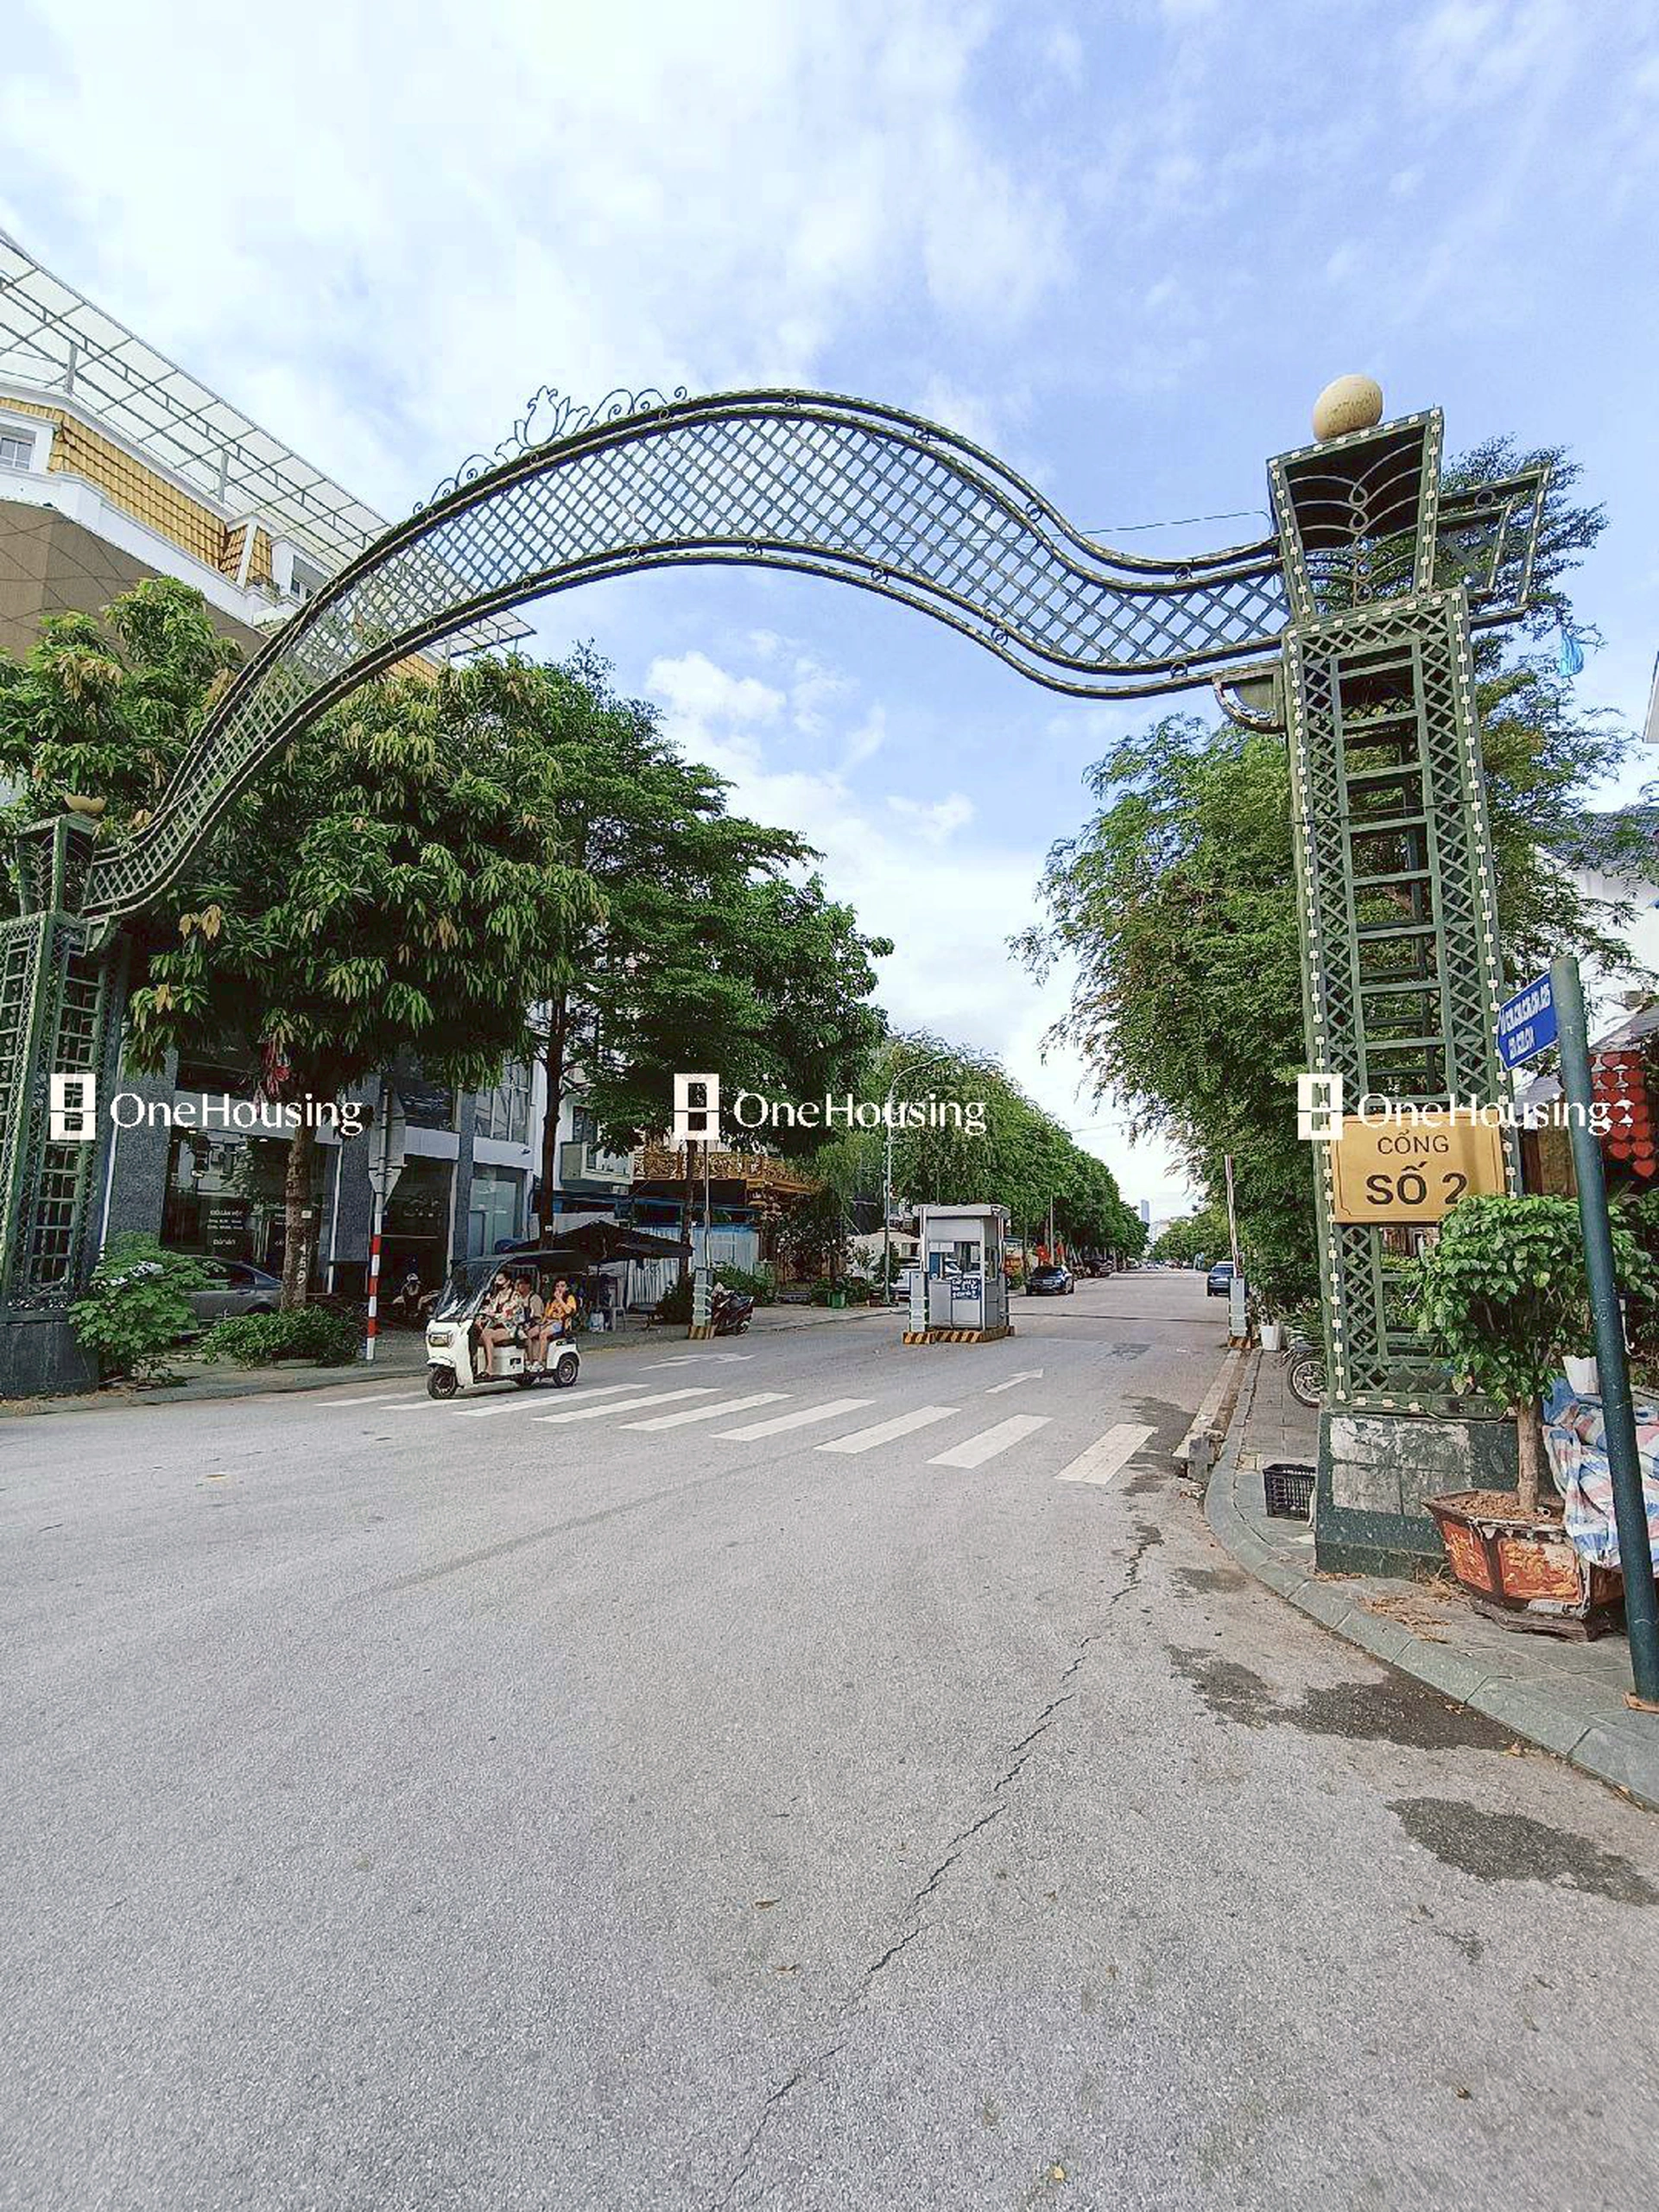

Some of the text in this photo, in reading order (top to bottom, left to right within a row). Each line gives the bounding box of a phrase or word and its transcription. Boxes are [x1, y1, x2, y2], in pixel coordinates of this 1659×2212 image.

[1377, 1128, 1450, 1155] CỔNG
[1365, 1161, 1469, 1206] SỐ 2
